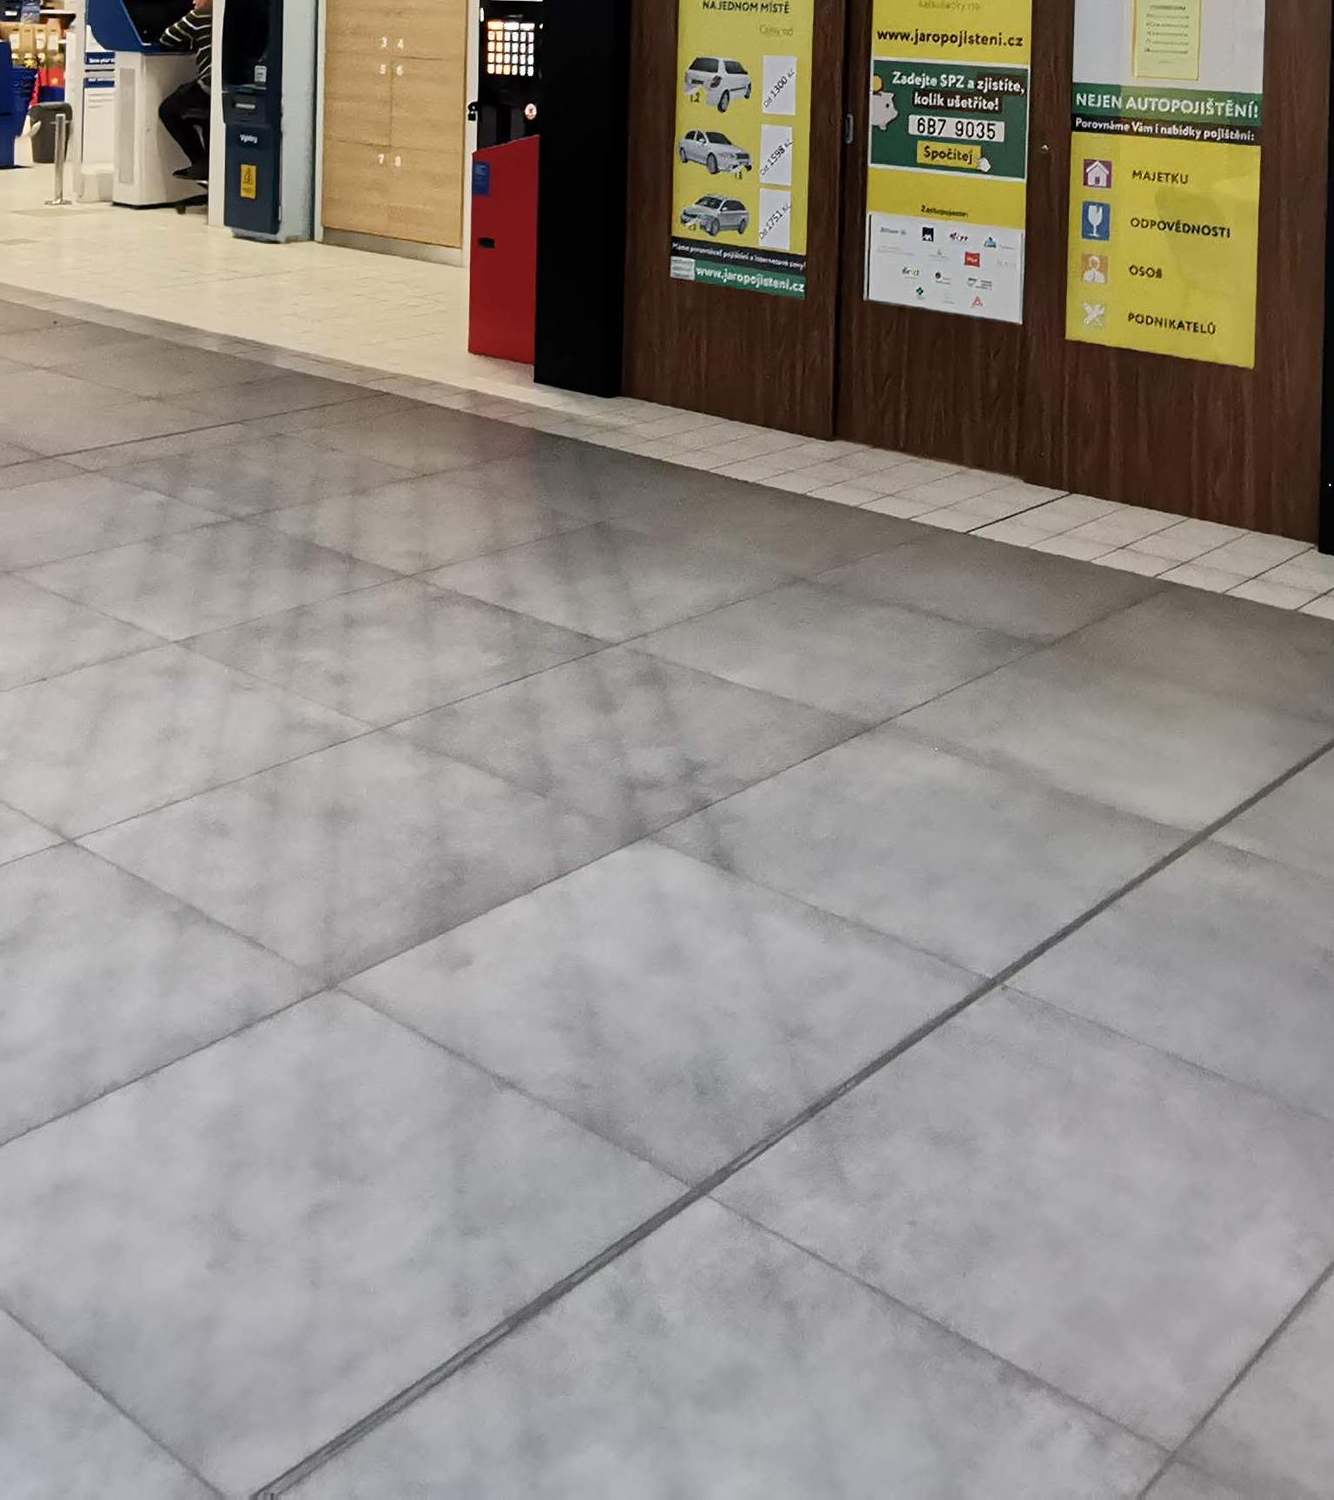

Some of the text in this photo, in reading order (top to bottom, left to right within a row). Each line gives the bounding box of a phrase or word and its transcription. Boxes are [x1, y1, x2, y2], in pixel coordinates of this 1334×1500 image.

[877, 29, 1023, 47] www.jaropojisteni.cz
[771, 76, 788, 97] 1300
[892, 71, 1026, 95] Zadejte SPZ a zjistíte,
[914, 92, 999, 110] kolik ušetříte!
[1075, 93, 1259, 118] NEJEN AUTOPOJIŠTĚNÍ!
[917, 118, 996, 139] 6B7 9035
[1075, 117, 1130, 132] Porovnáme
[1131, 121, 1153, 134] Vám
[1160, 124, 1202, 139] nabídky
[1203, 128, 1255, 142] pojištění:
[1132, 170, 1189, 184] MAJETKU
[1130, 217, 1231, 238] ODPOVĚDNOSTI
[1128, 265, 1163, 279] OSOB
[1127, 312, 1217, 335] PODNIKATELŮ
